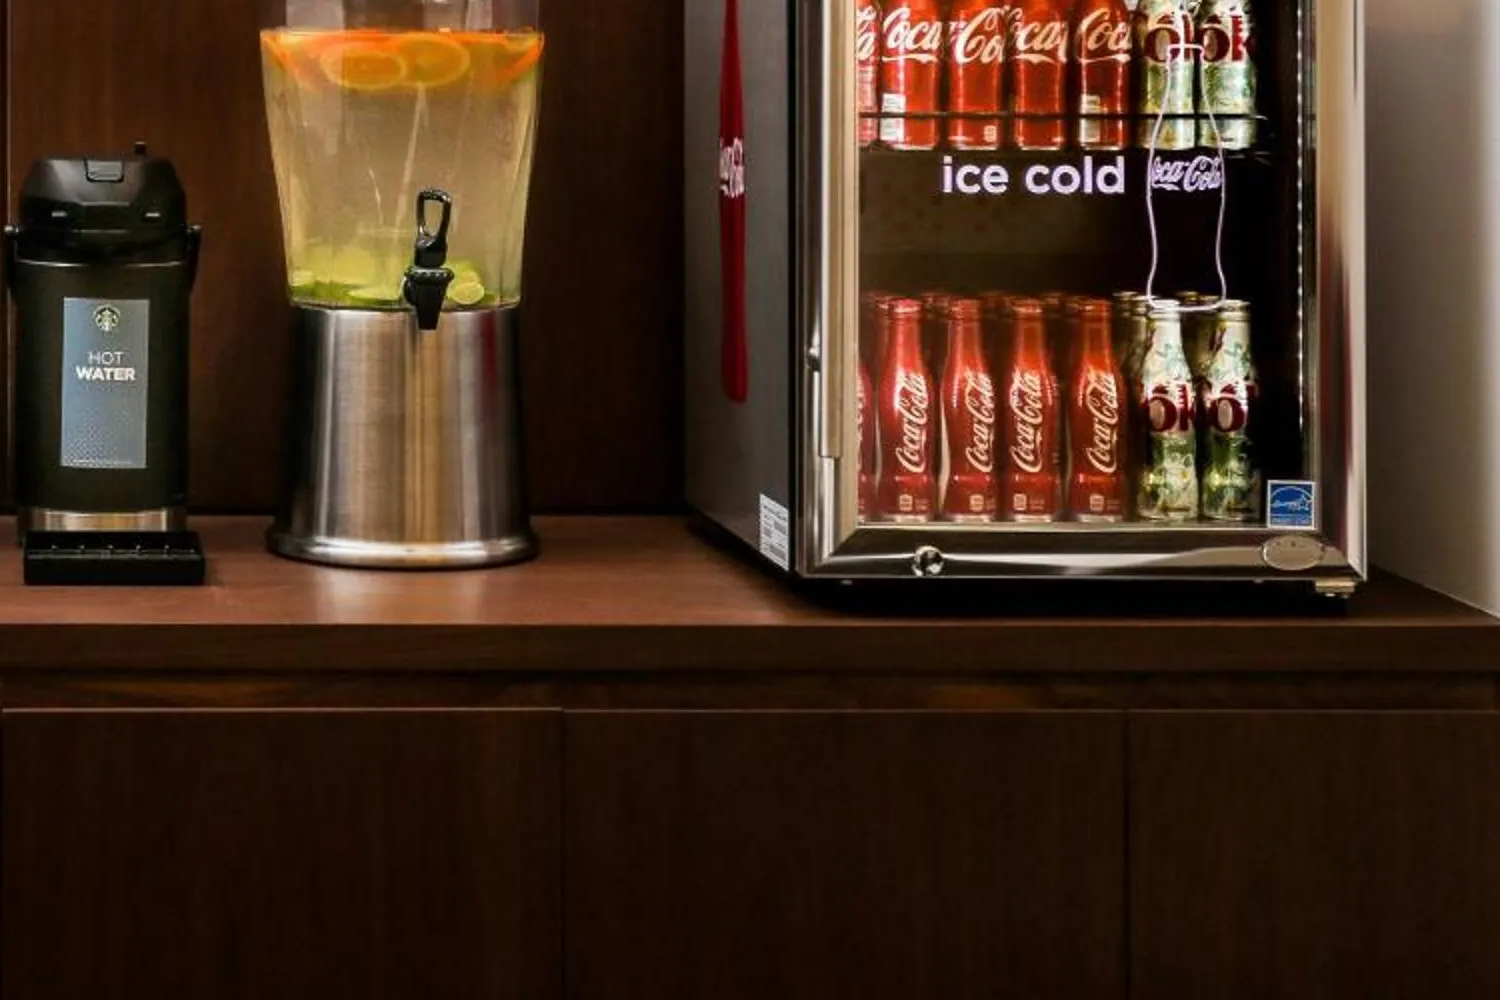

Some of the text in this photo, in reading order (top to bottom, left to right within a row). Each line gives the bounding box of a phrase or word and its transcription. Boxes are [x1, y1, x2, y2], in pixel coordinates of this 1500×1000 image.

[942, 155, 1125, 194] ice cold
[87, 351, 124, 365] HOT
[75, 366, 136, 381] WATER
